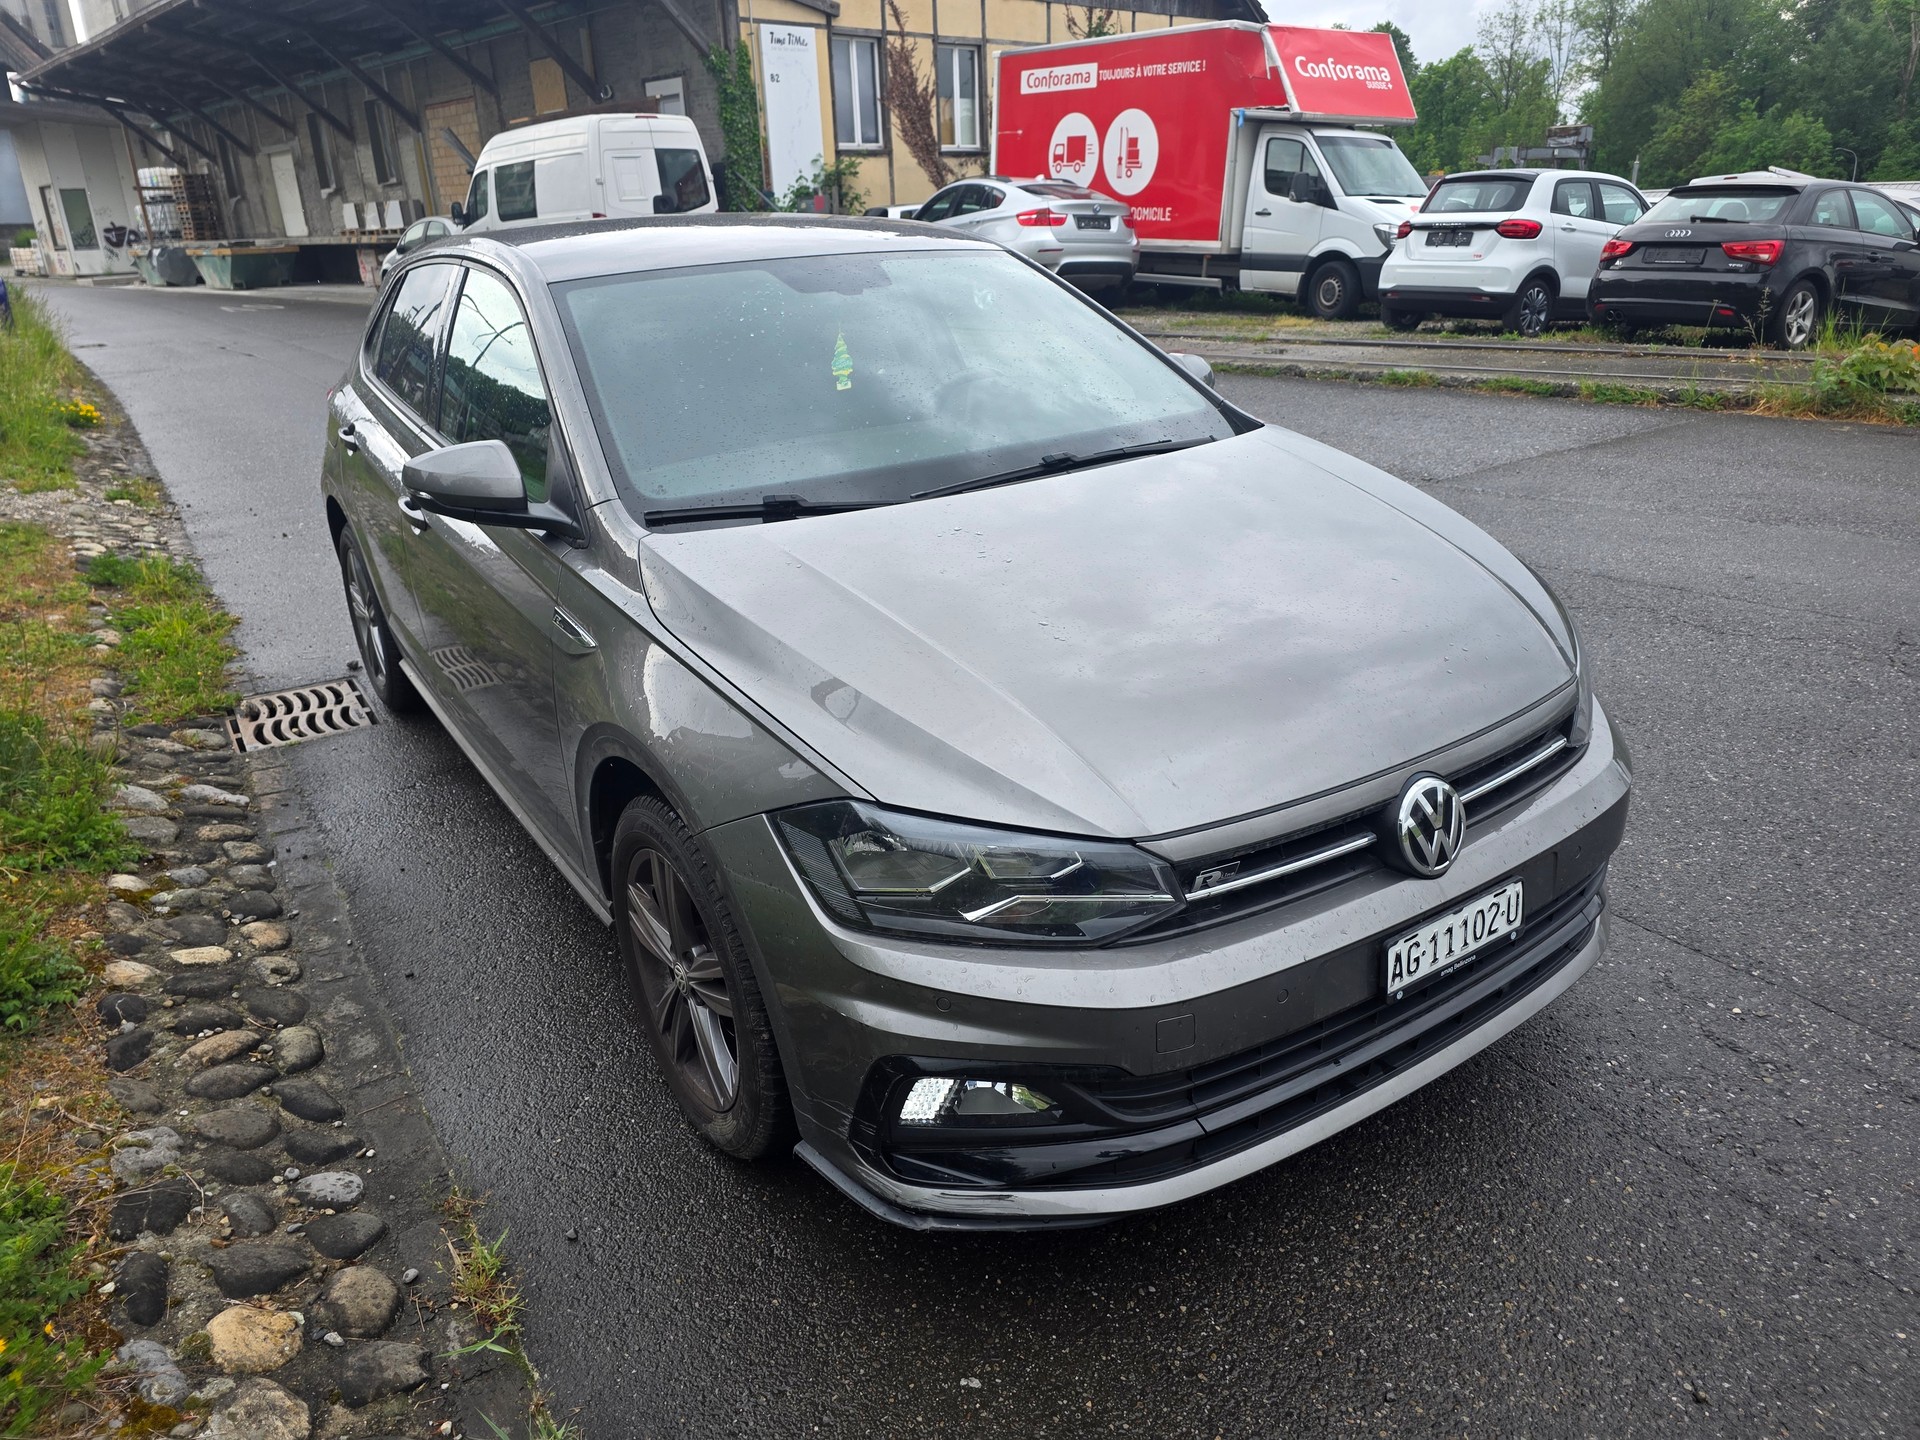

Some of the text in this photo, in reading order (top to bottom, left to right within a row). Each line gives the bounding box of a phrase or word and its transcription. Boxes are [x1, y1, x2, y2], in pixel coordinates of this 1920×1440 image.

[1026, 70, 1091, 89] Conforama
[1098, 67, 1135, 81] TOUJOURS
[1135, 64, 1142, 78] À
[1143, 63, 1167, 77] VOTRE
[1167, 60, 1201, 74] SERVICE
[1294, 55, 1391, 82] Conforama
